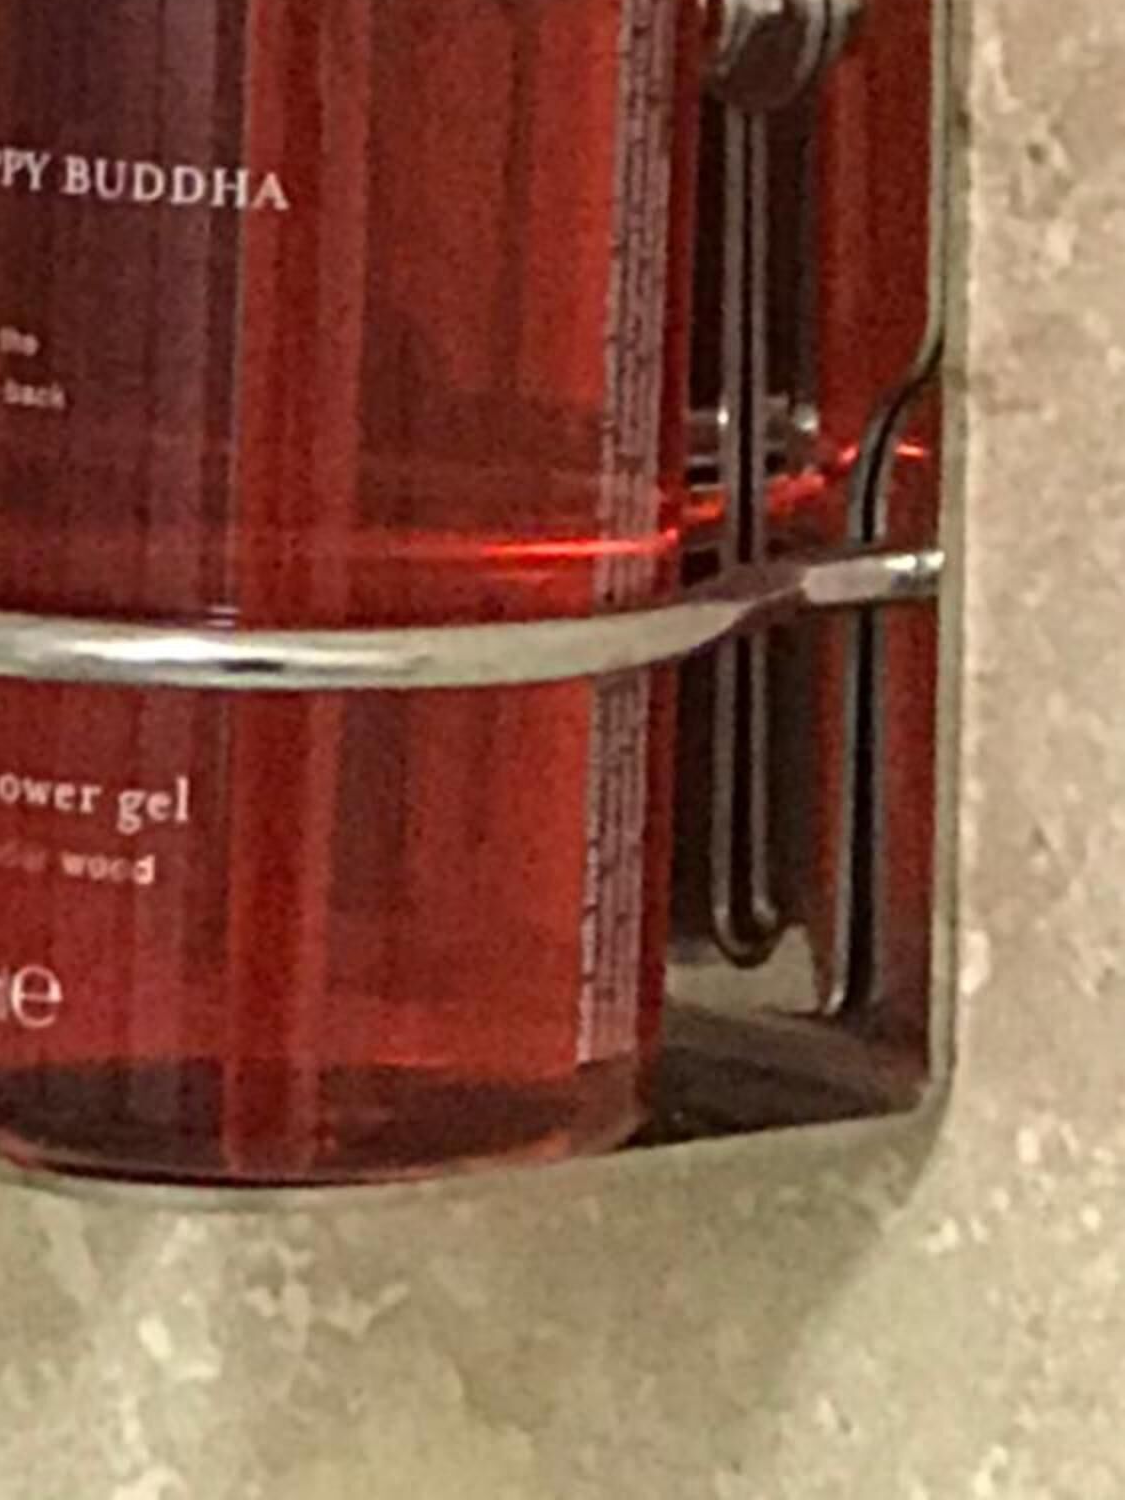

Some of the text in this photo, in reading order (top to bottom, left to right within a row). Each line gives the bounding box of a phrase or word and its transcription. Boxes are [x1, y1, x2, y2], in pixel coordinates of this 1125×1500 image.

[61, 155, 290, 211] BUDDHA
[115, 774, 190, 836] gel
[61, 853, 156, 886] wood
